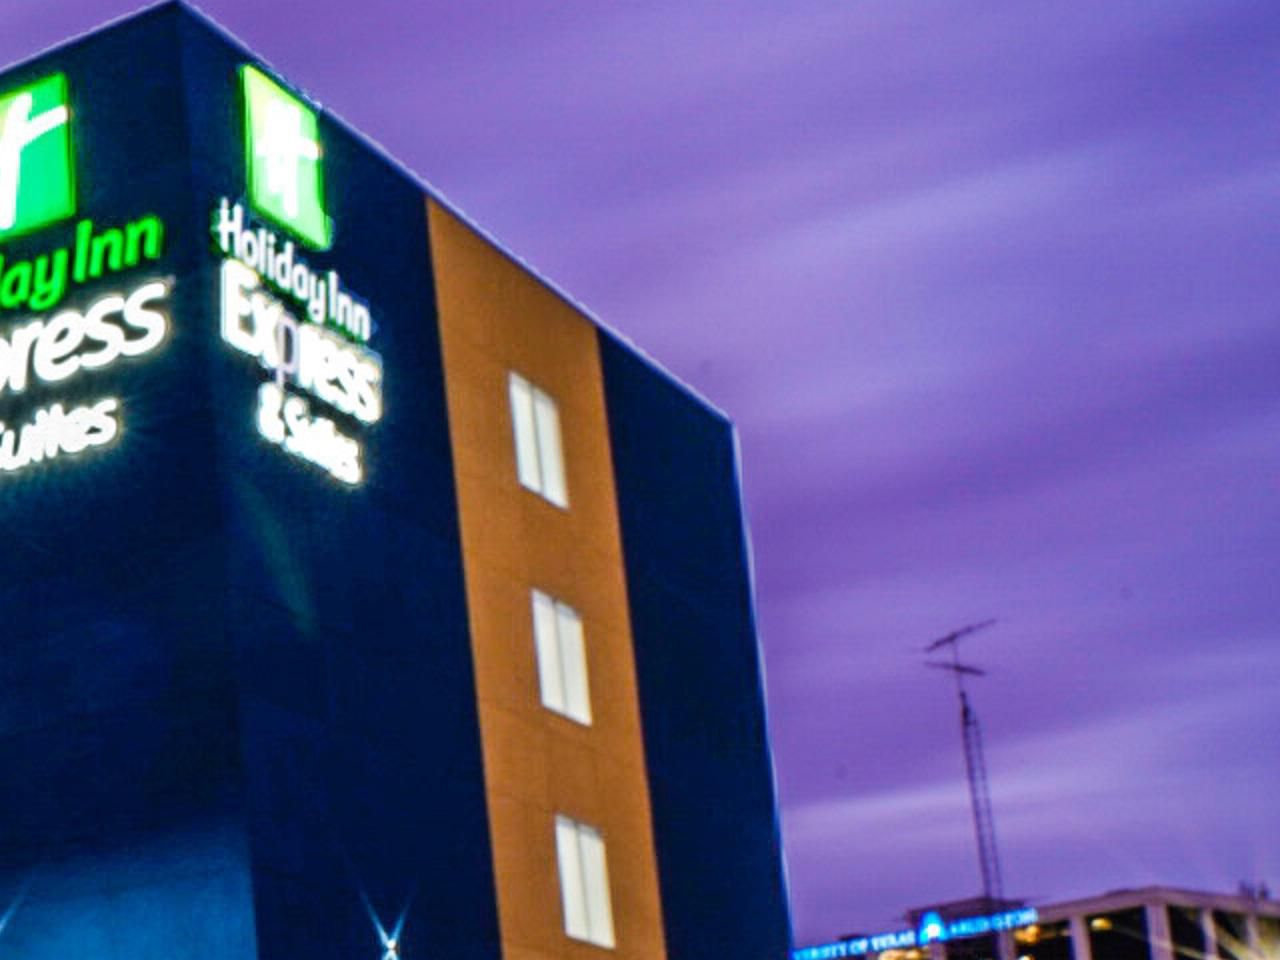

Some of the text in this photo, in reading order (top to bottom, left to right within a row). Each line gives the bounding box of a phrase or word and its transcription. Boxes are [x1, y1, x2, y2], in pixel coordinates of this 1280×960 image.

[73, 213, 165, 284] Inn
[217, 196, 372, 342] Holiday Inn
[220, 257, 383, 424] Express
[849, 938, 869, 956] OF
[871, 929, 917, 953] TEXAS
